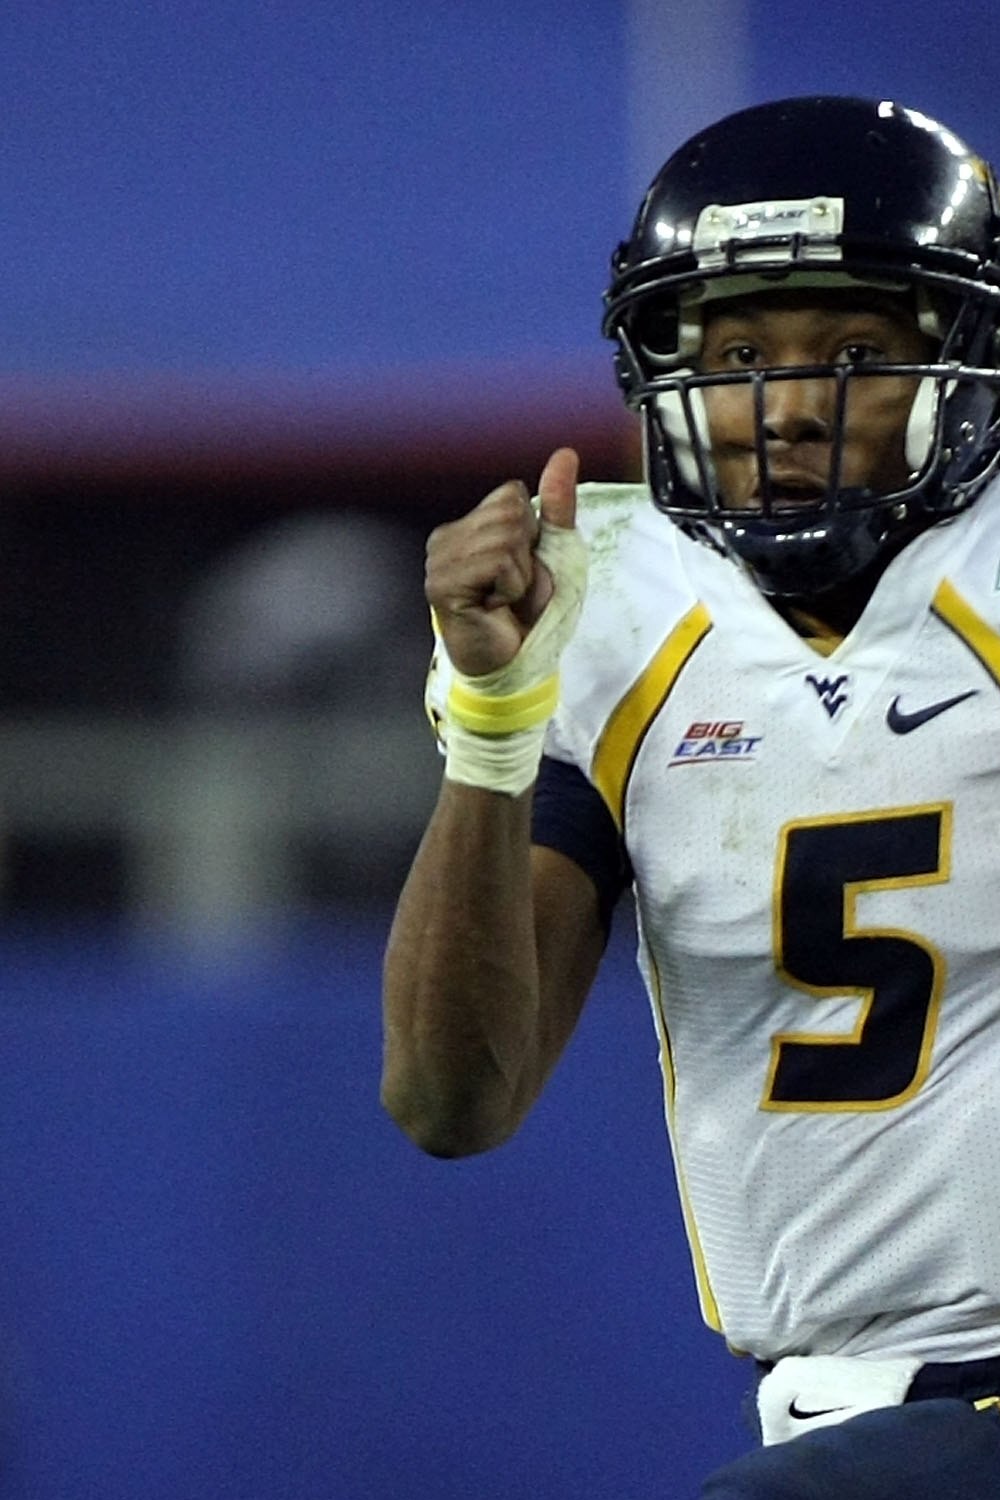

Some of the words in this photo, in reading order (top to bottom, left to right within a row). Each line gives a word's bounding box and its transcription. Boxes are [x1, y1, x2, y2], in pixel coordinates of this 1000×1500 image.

[684, 721, 744, 740] BIG
[674, 737, 763, 757] EAST
[758, 800, 954, 1113] 5
